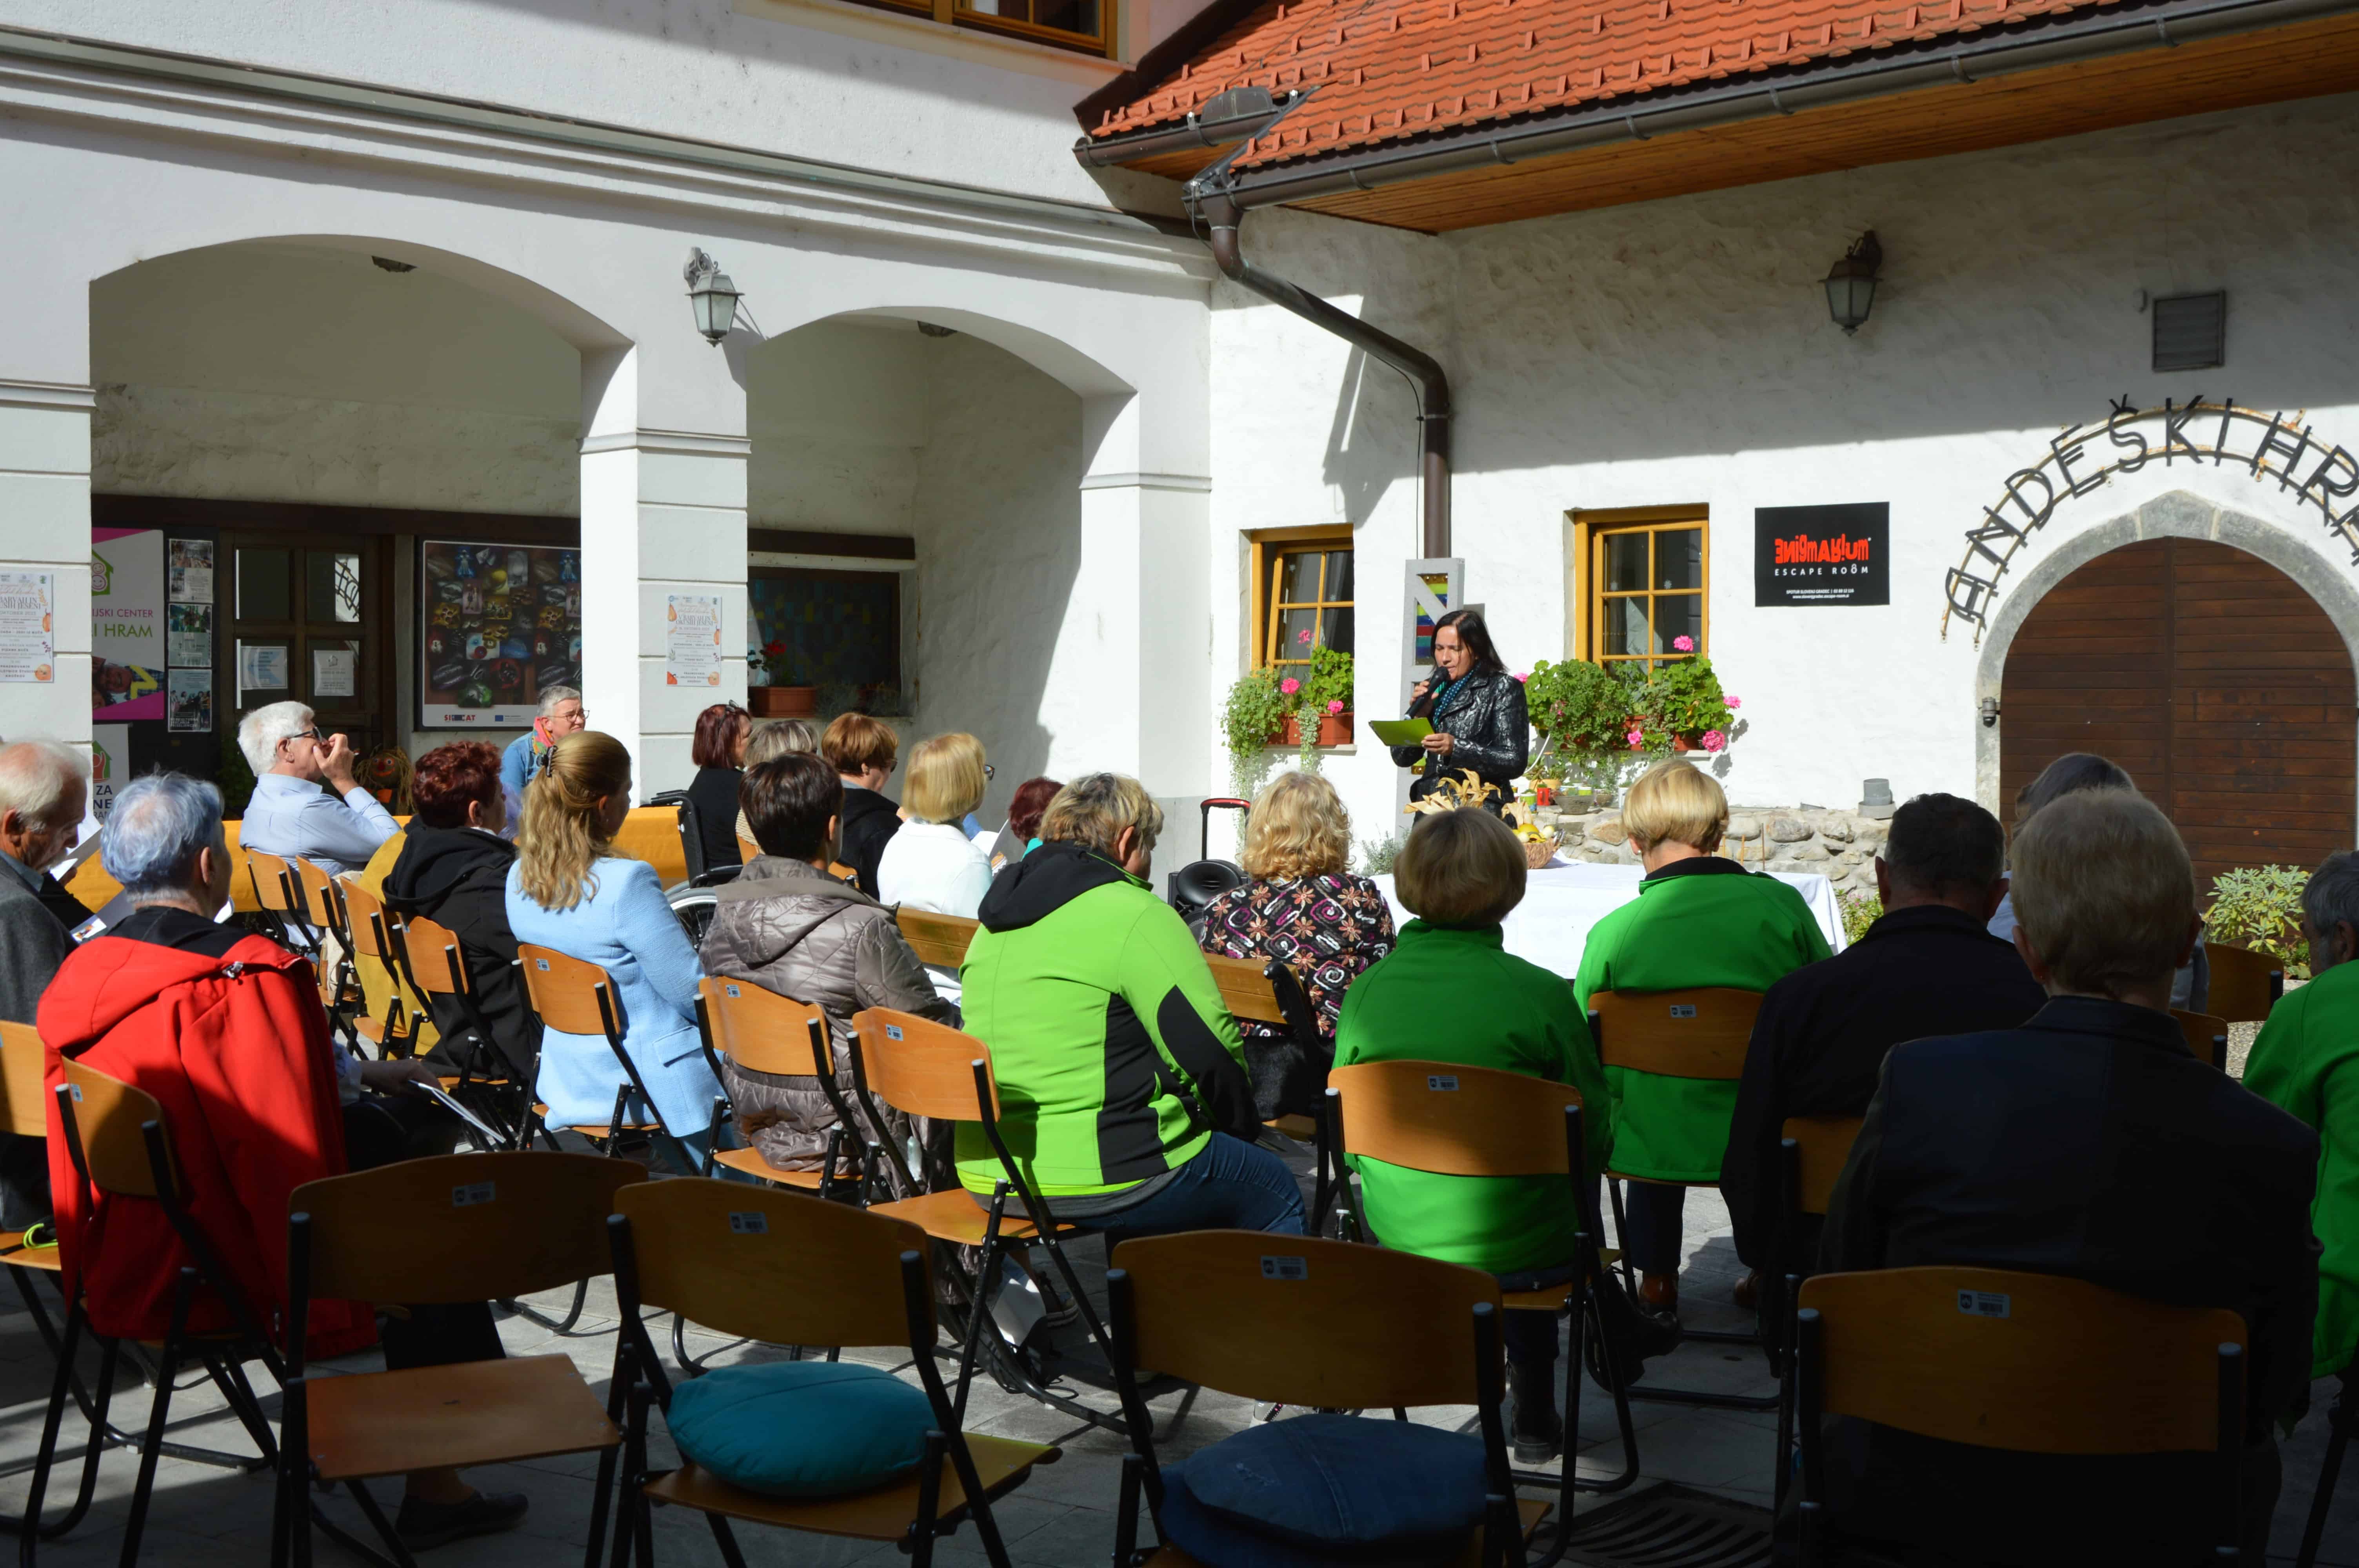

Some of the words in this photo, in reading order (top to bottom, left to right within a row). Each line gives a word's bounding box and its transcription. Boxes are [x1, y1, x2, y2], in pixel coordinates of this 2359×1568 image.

[1775, 568, 1823, 576] ESCAPE
[117, 608, 153, 618] CENTER
[104, 623, 153, 637] HRAM
[96, 785, 112, 795] ZA
[93, 799, 112, 809] NE
